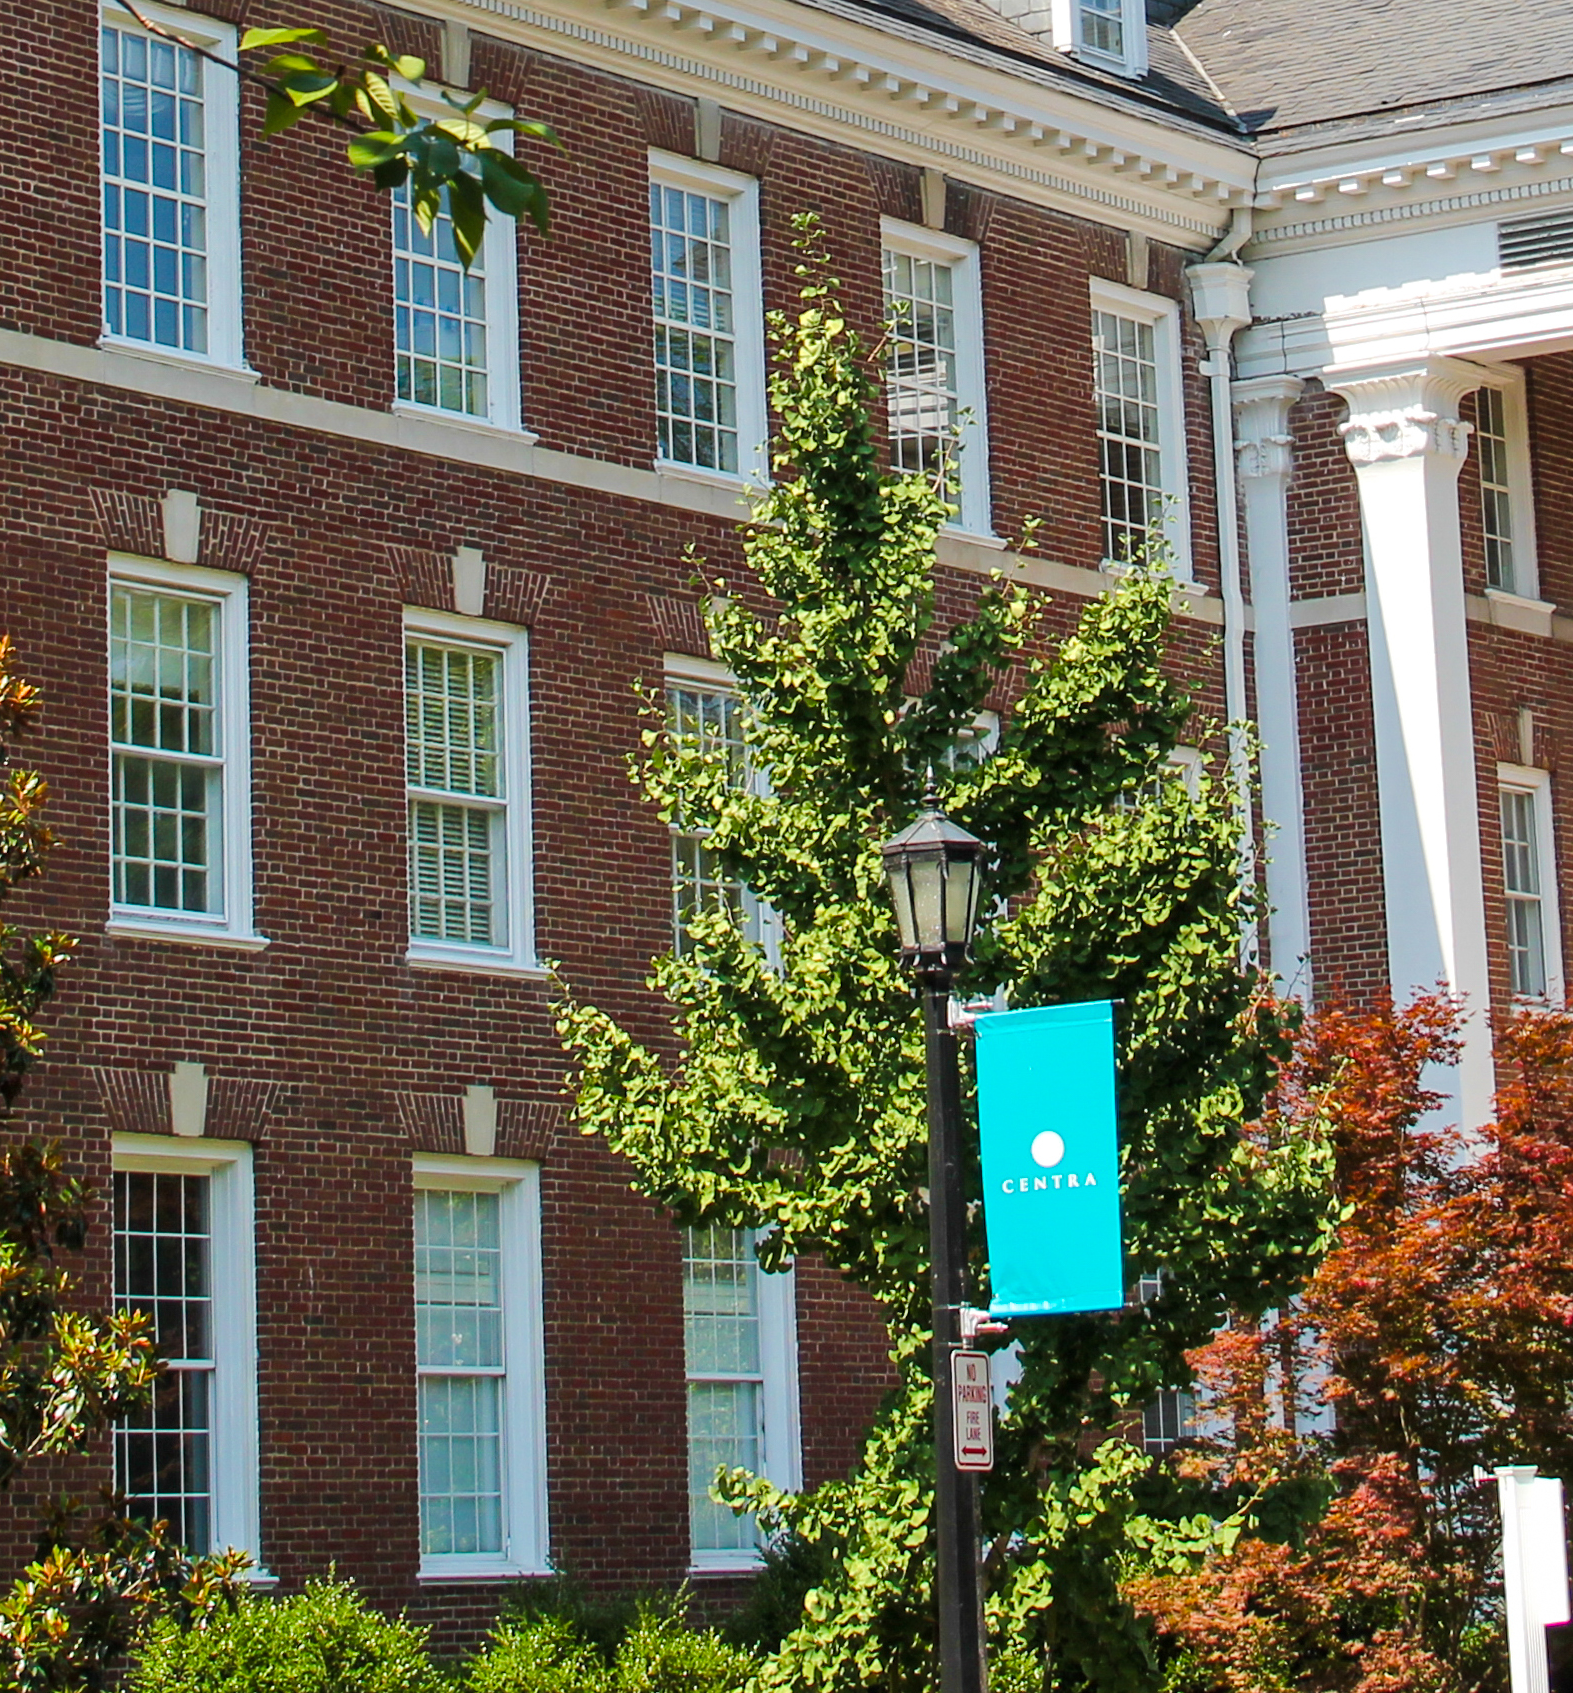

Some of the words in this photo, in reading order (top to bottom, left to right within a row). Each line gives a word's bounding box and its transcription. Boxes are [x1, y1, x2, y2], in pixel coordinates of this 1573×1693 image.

[1001, 1172, 1097, 1194] CENTRA
[966, 1363, 977, 1382] NO
[958, 1384, 987, 1404] PARKING
[966, 1411, 980, 1425] FIRE
[966, 1427, 981, 1441] LANE
